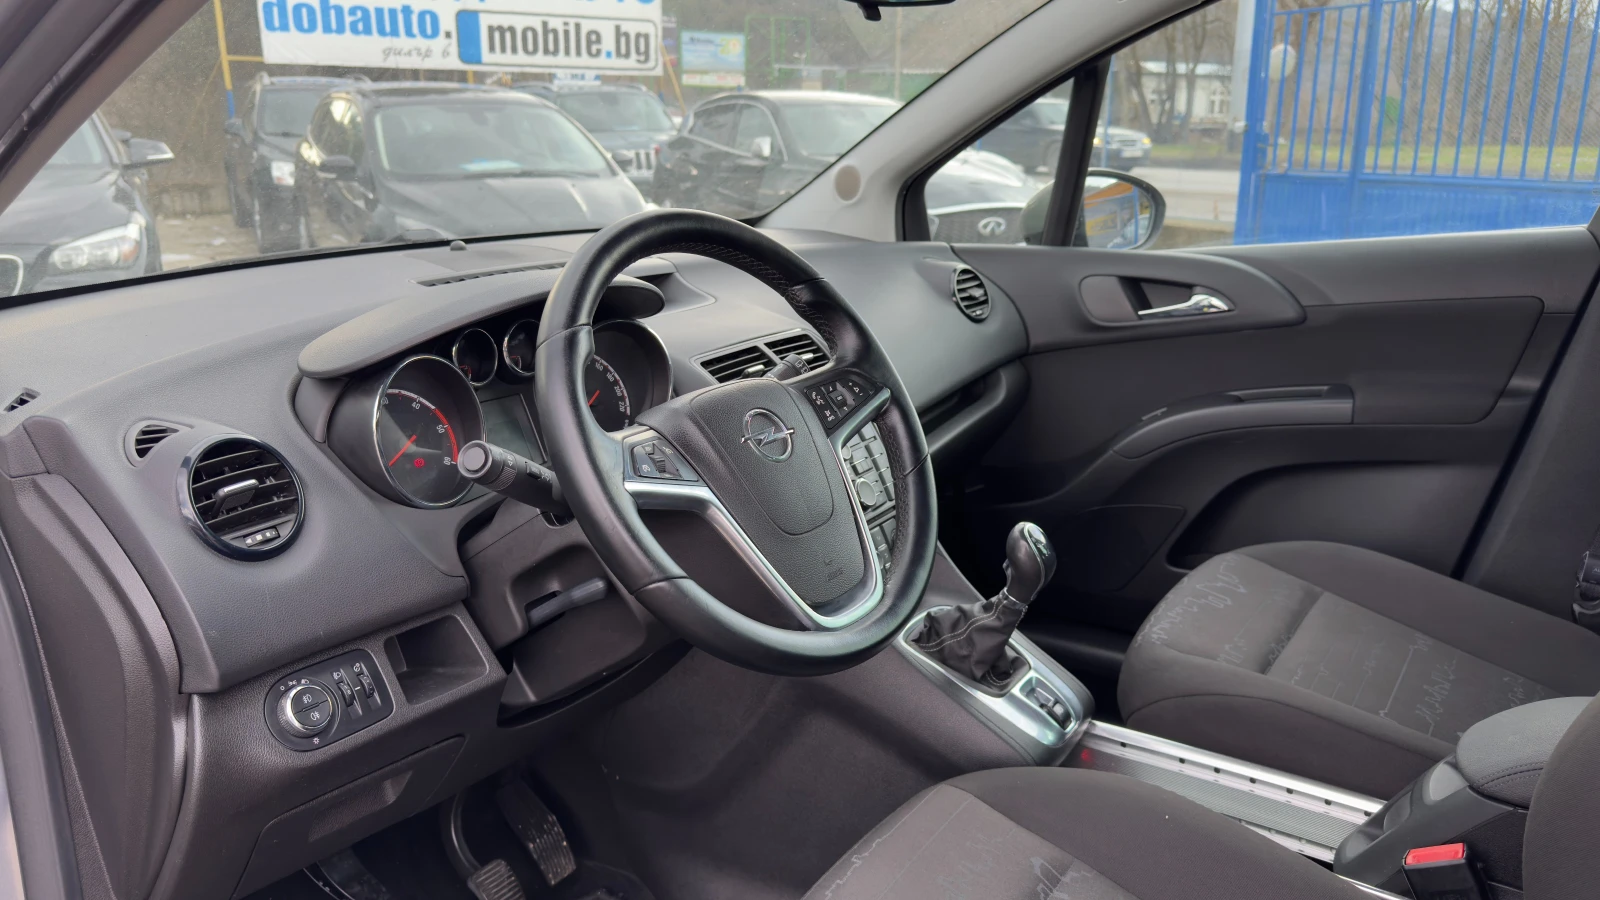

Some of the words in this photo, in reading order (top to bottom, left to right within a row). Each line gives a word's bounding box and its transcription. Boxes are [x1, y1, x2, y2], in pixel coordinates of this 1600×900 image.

[487, 20, 651, 64] mobile.bg
[411, 402, 420, 410] 40
[436, 424, 445, 434] 50
[443, 456, 451, 466] 60
